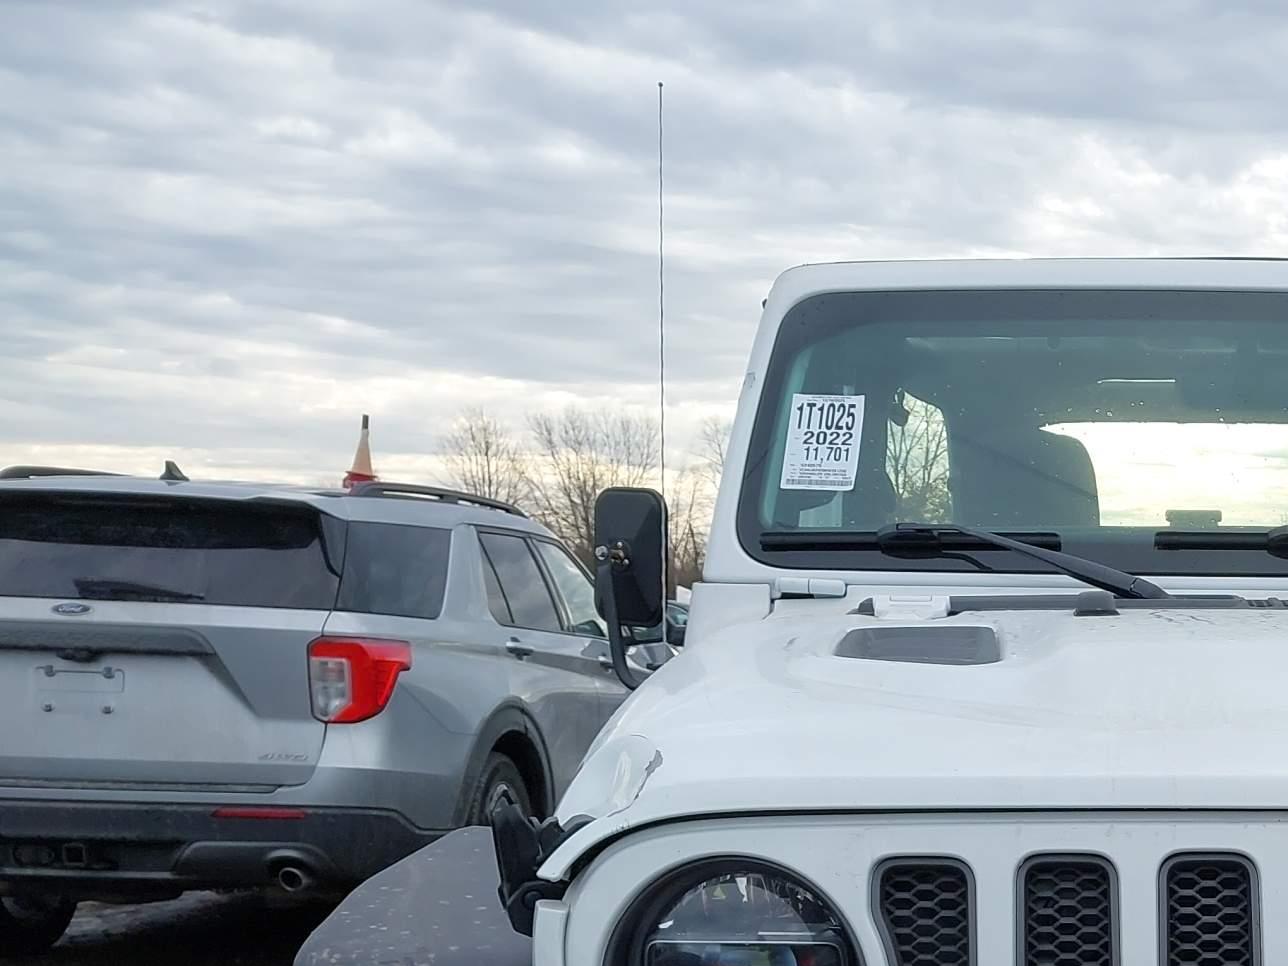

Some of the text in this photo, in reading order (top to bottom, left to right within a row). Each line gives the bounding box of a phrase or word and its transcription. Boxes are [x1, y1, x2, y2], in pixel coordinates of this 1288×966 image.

[796, 402, 857, 431] 1T1025
[802, 430, 854, 446] 2022
[805, 446, 850, 463] 11,701
